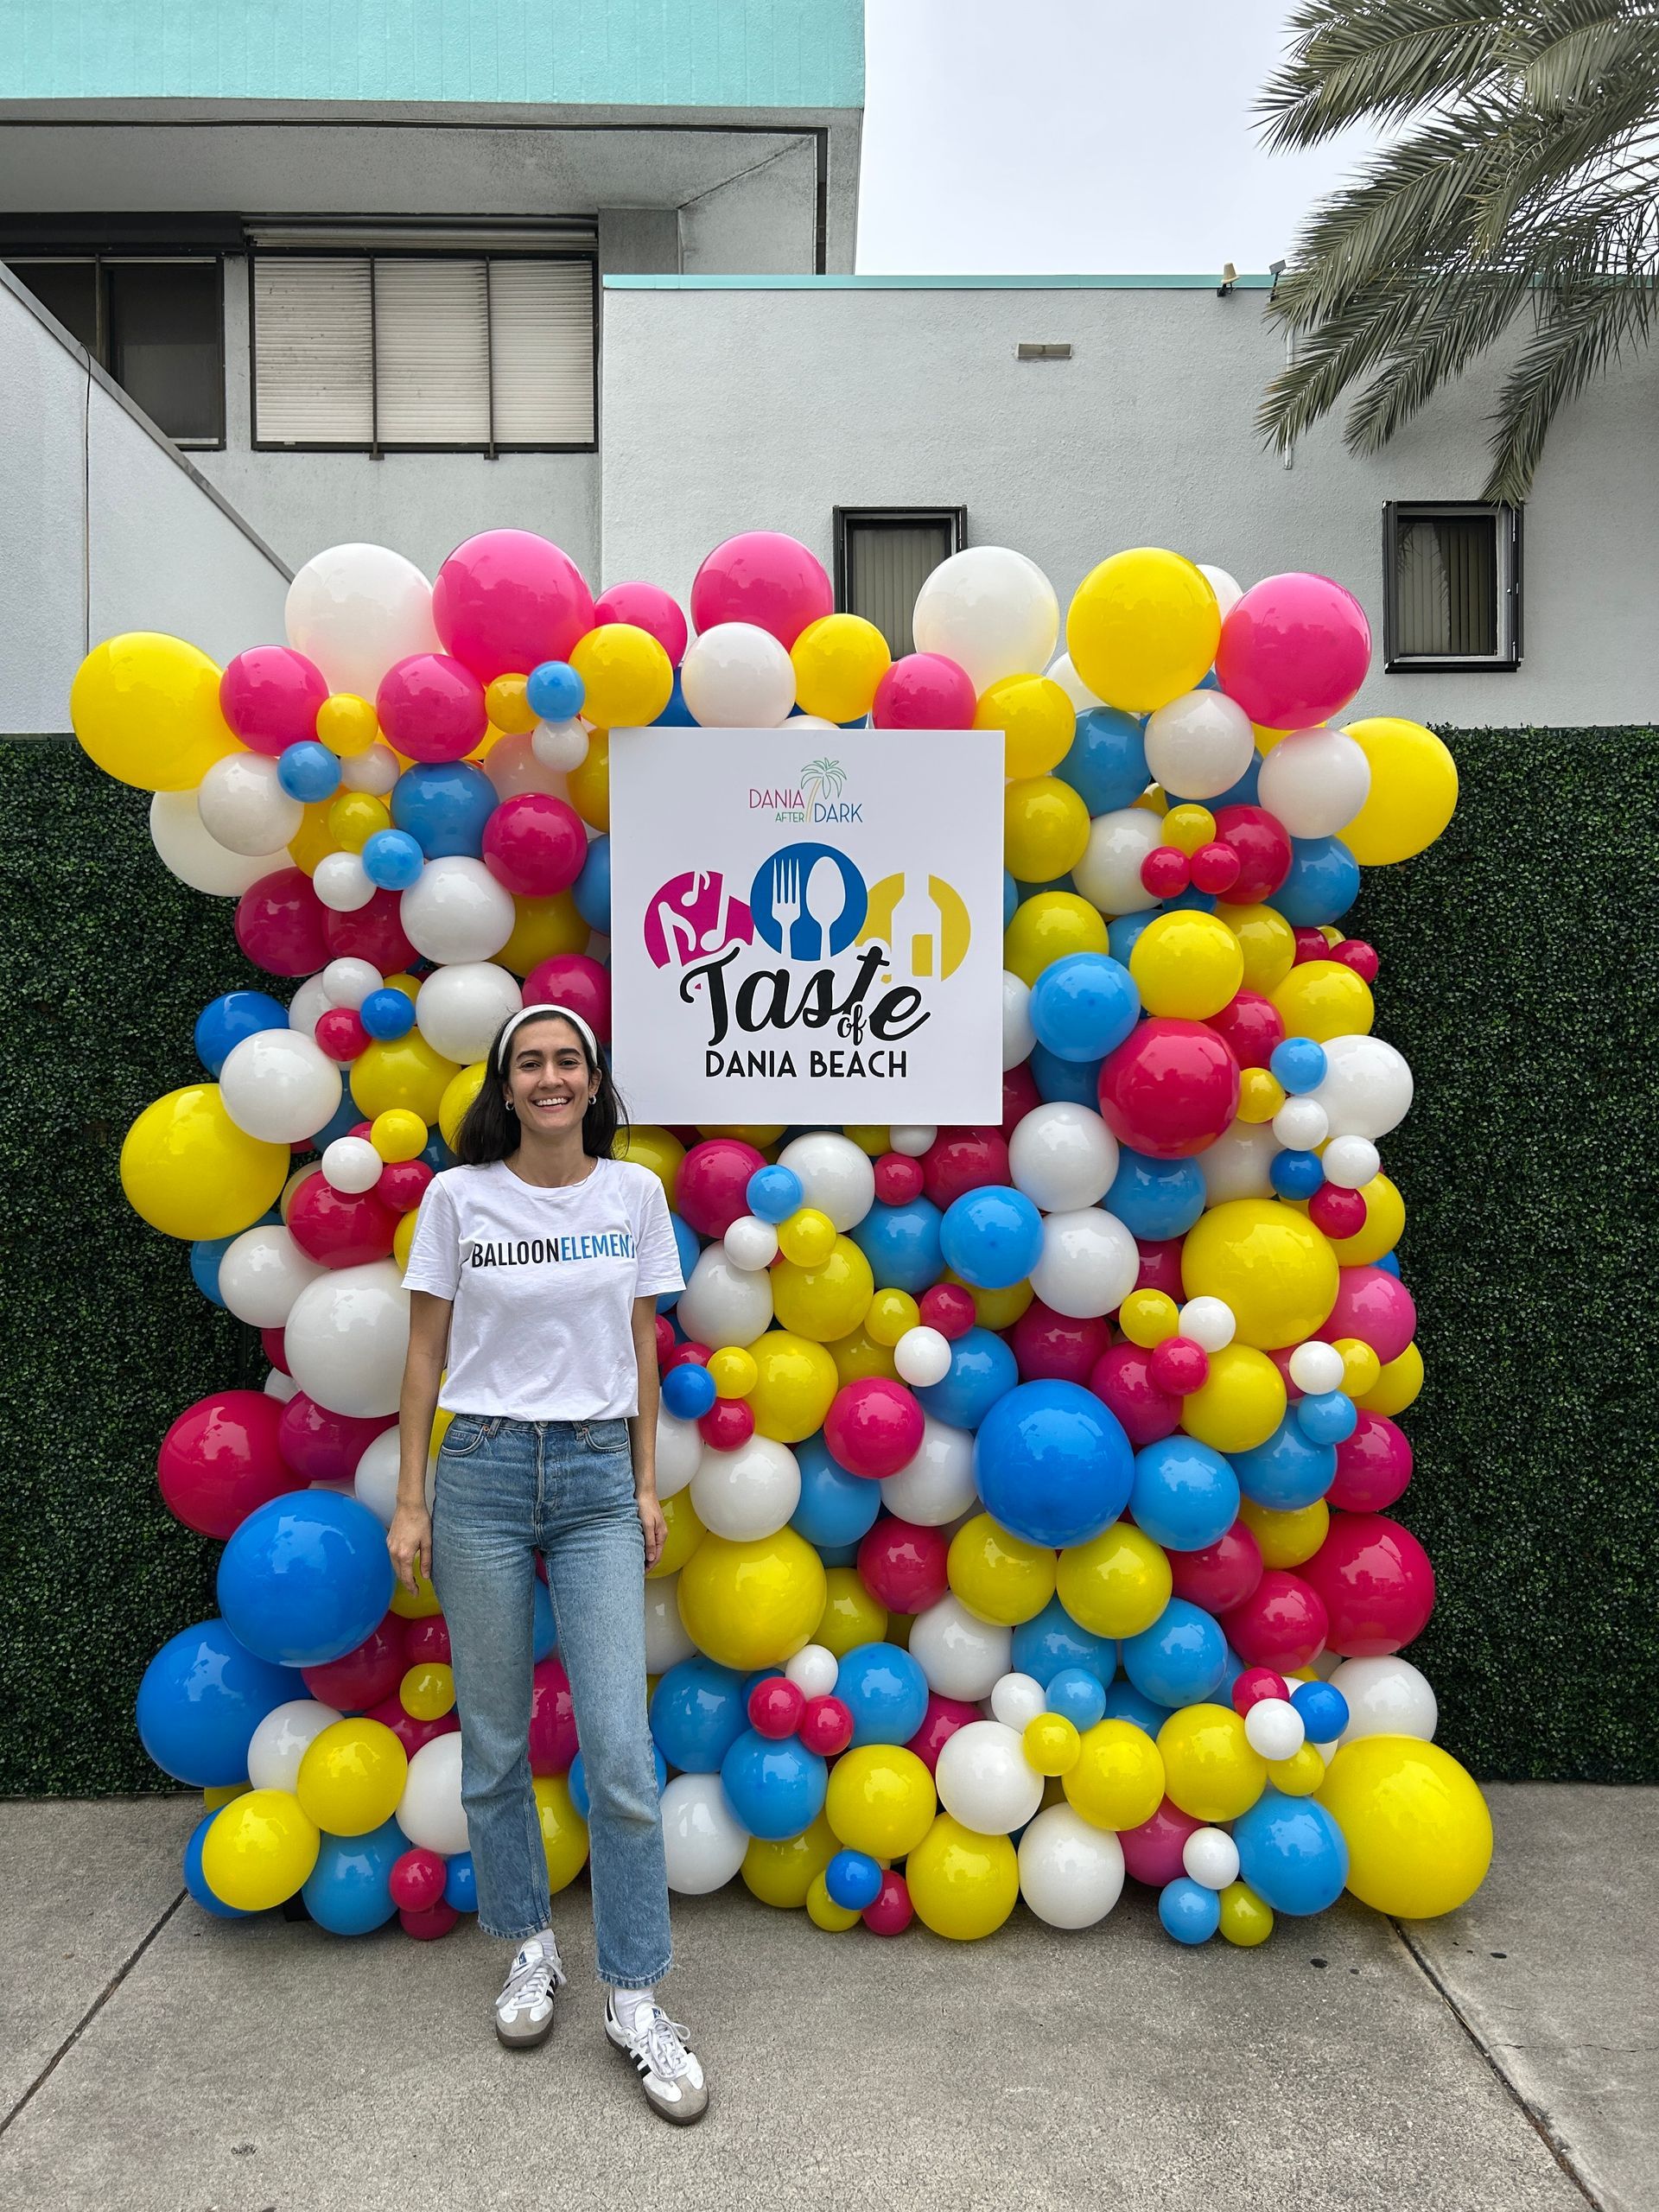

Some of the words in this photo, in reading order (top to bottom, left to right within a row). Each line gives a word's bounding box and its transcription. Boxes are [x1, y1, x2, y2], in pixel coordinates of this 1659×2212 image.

[749, 788, 805, 809] DANIA
[775, 811, 804, 823] AFTER
[814, 803, 863, 823] DARK
[679, 945, 931, 1046] Taste
[836, 1004, 868, 1046] of
[705, 1050, 798, 1077] DANIA
[810, 1050, 907, 1077] BEACH
